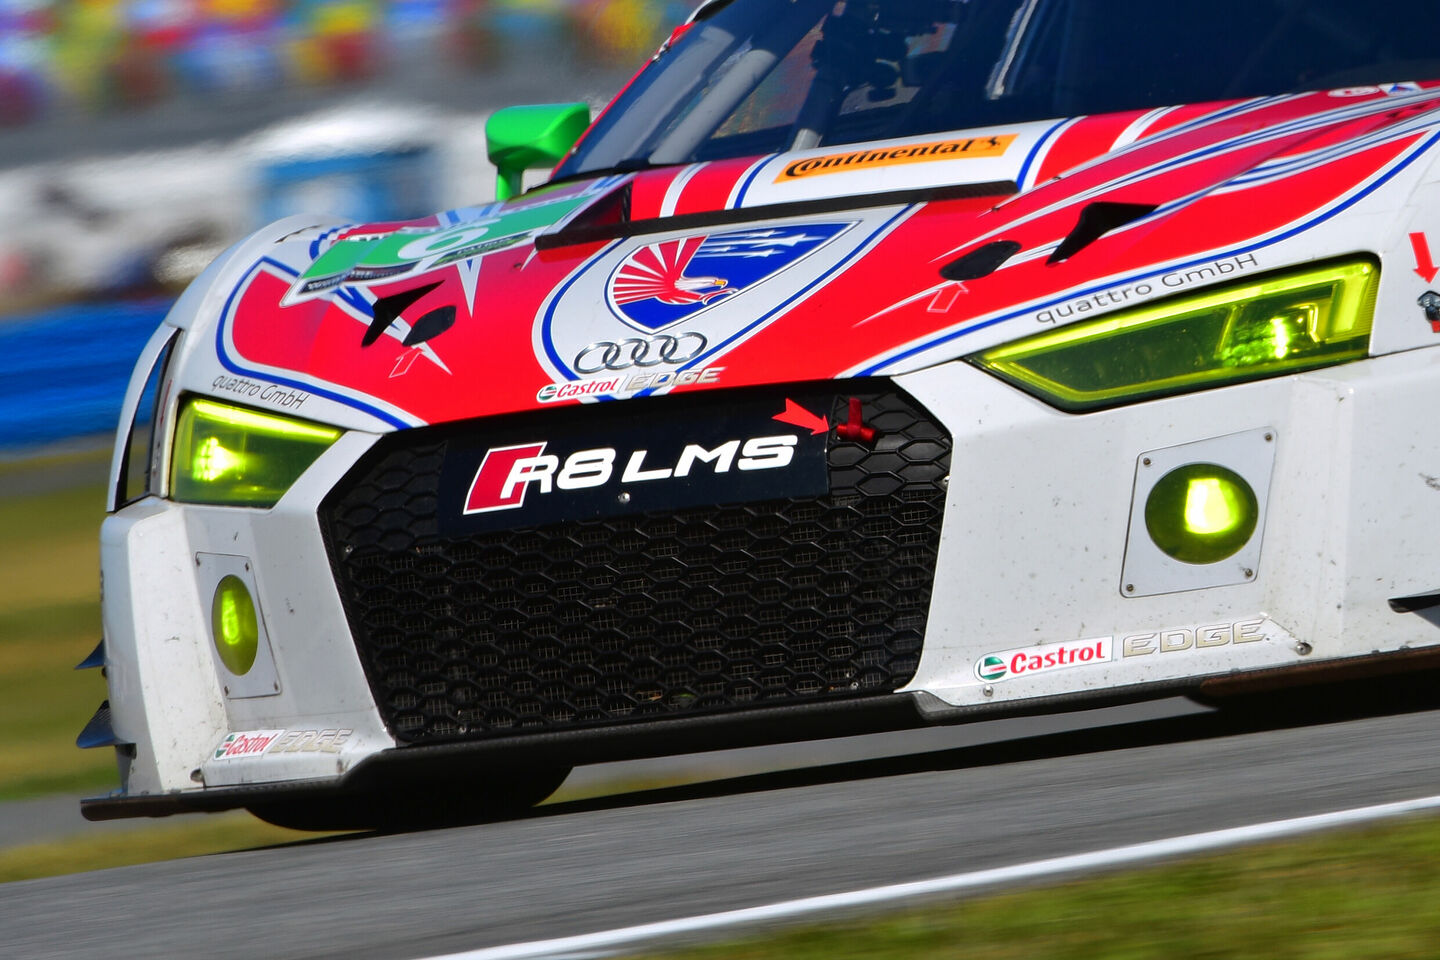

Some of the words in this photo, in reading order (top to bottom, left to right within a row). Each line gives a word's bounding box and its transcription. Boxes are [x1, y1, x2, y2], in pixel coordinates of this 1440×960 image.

[785, 139, 976, 177] Continental
[1036, 284, 1153, 324] quattro
[1161, 253, 1259, 288] GmbH
[212, 375, 262, 397] quattro
[260, 385, 311, 410] GmbH
[557, 378, 621, 399] Castrol
[624, 367, 727, 390] EDGE
[500, 448, 617, 500] R8
[621, 434, 798, 483] LMS
[1010, 641, 1106, 674] Castrol
[1122, 618, 1268, 658] EDGE
[226, 733, 279, 756] Castrol
[267, 729, 353, 754] EDGE
